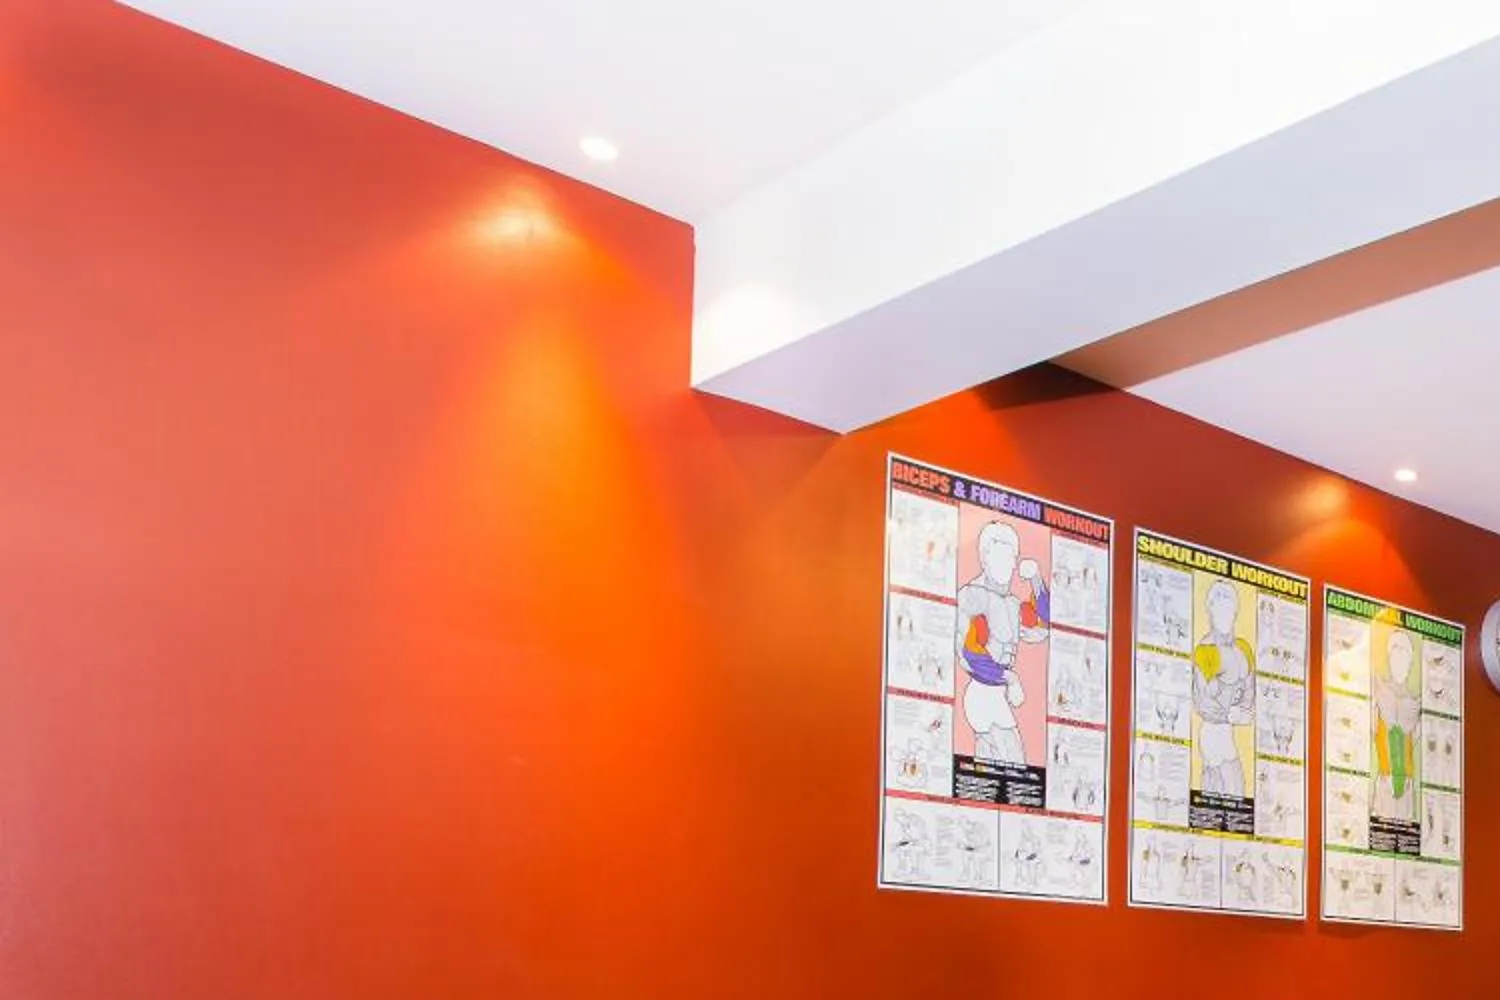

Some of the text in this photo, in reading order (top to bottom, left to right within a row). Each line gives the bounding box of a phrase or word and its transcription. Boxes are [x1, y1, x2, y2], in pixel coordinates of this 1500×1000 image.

[893, 461, 950, 492] BICEPS
[953, 479, 966, 499] &
[971, 484, 1041, 521] FOREARM
[1044, 507, 1109, 539] WORKOUT
[1137, 535, 1229, 574] SHOULDER
[1231, 563, 1308, 597] WORKOUT
[1406, 613, 1460, 641] WORKOUT
